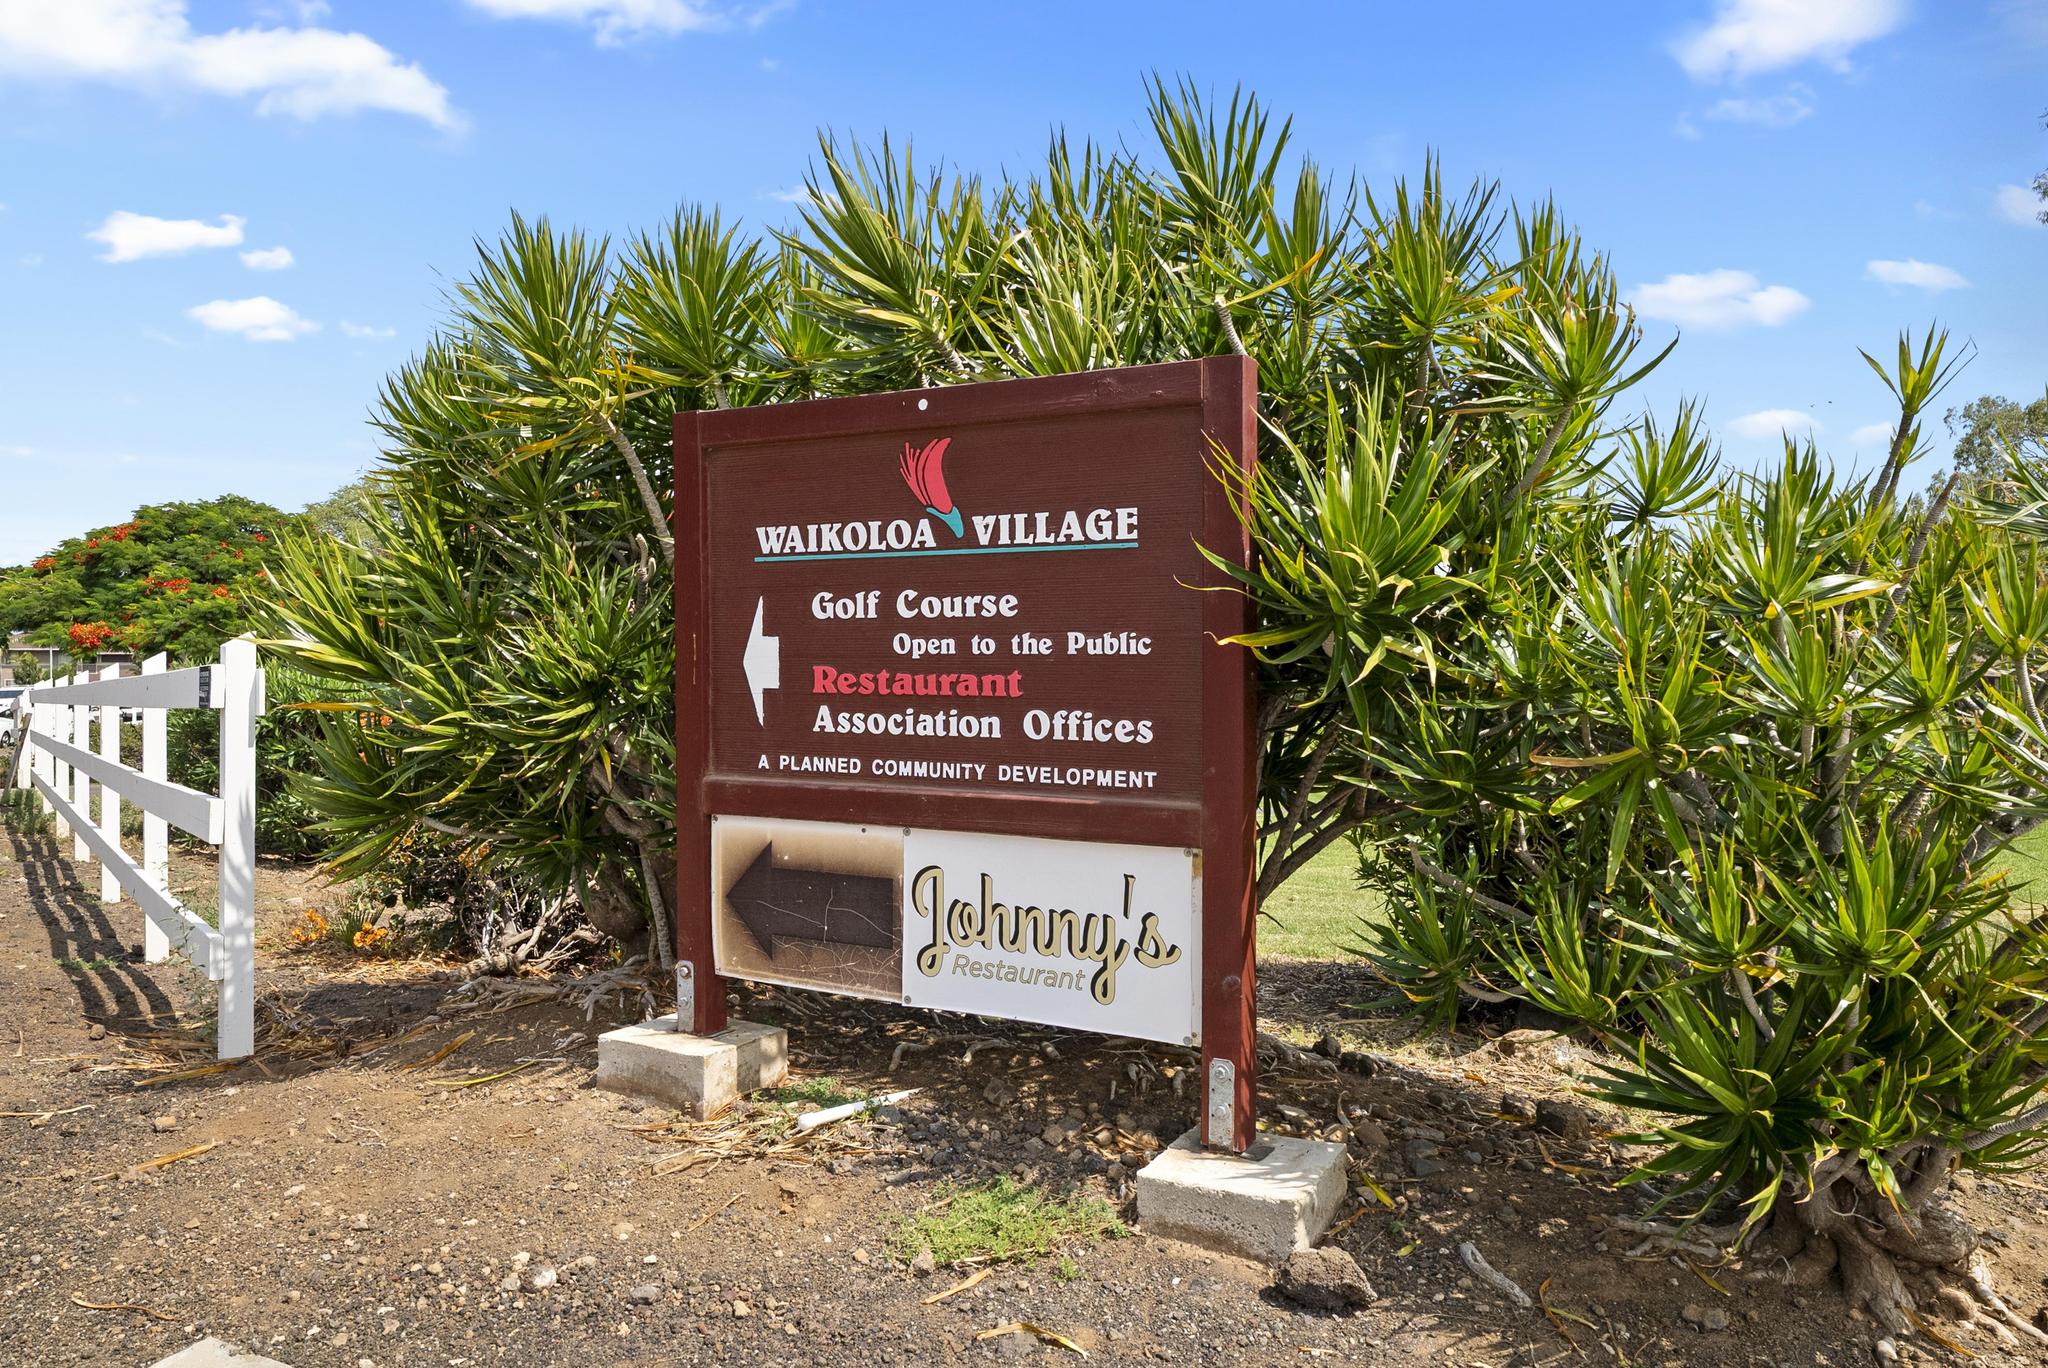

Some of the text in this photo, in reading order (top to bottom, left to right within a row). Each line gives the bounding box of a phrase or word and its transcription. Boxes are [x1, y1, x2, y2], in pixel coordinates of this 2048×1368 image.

[755, 507, 1139, 554] WAIKOLOA VILLAGE
[811, 590, 1019, 620] Golf Course
[892, 632, 1152, 658] Open to the Public
[812, 666, 1024, 698] Restaurant
[813, 705, 1154, 744] Association Offices
[758, 755, 1158, 788] A PLANNED COMMUNITY DEVELOPMENT
[912, 865, 1182, 1006] Johnny's
[952, 953, 1086, 992] Restaurant
